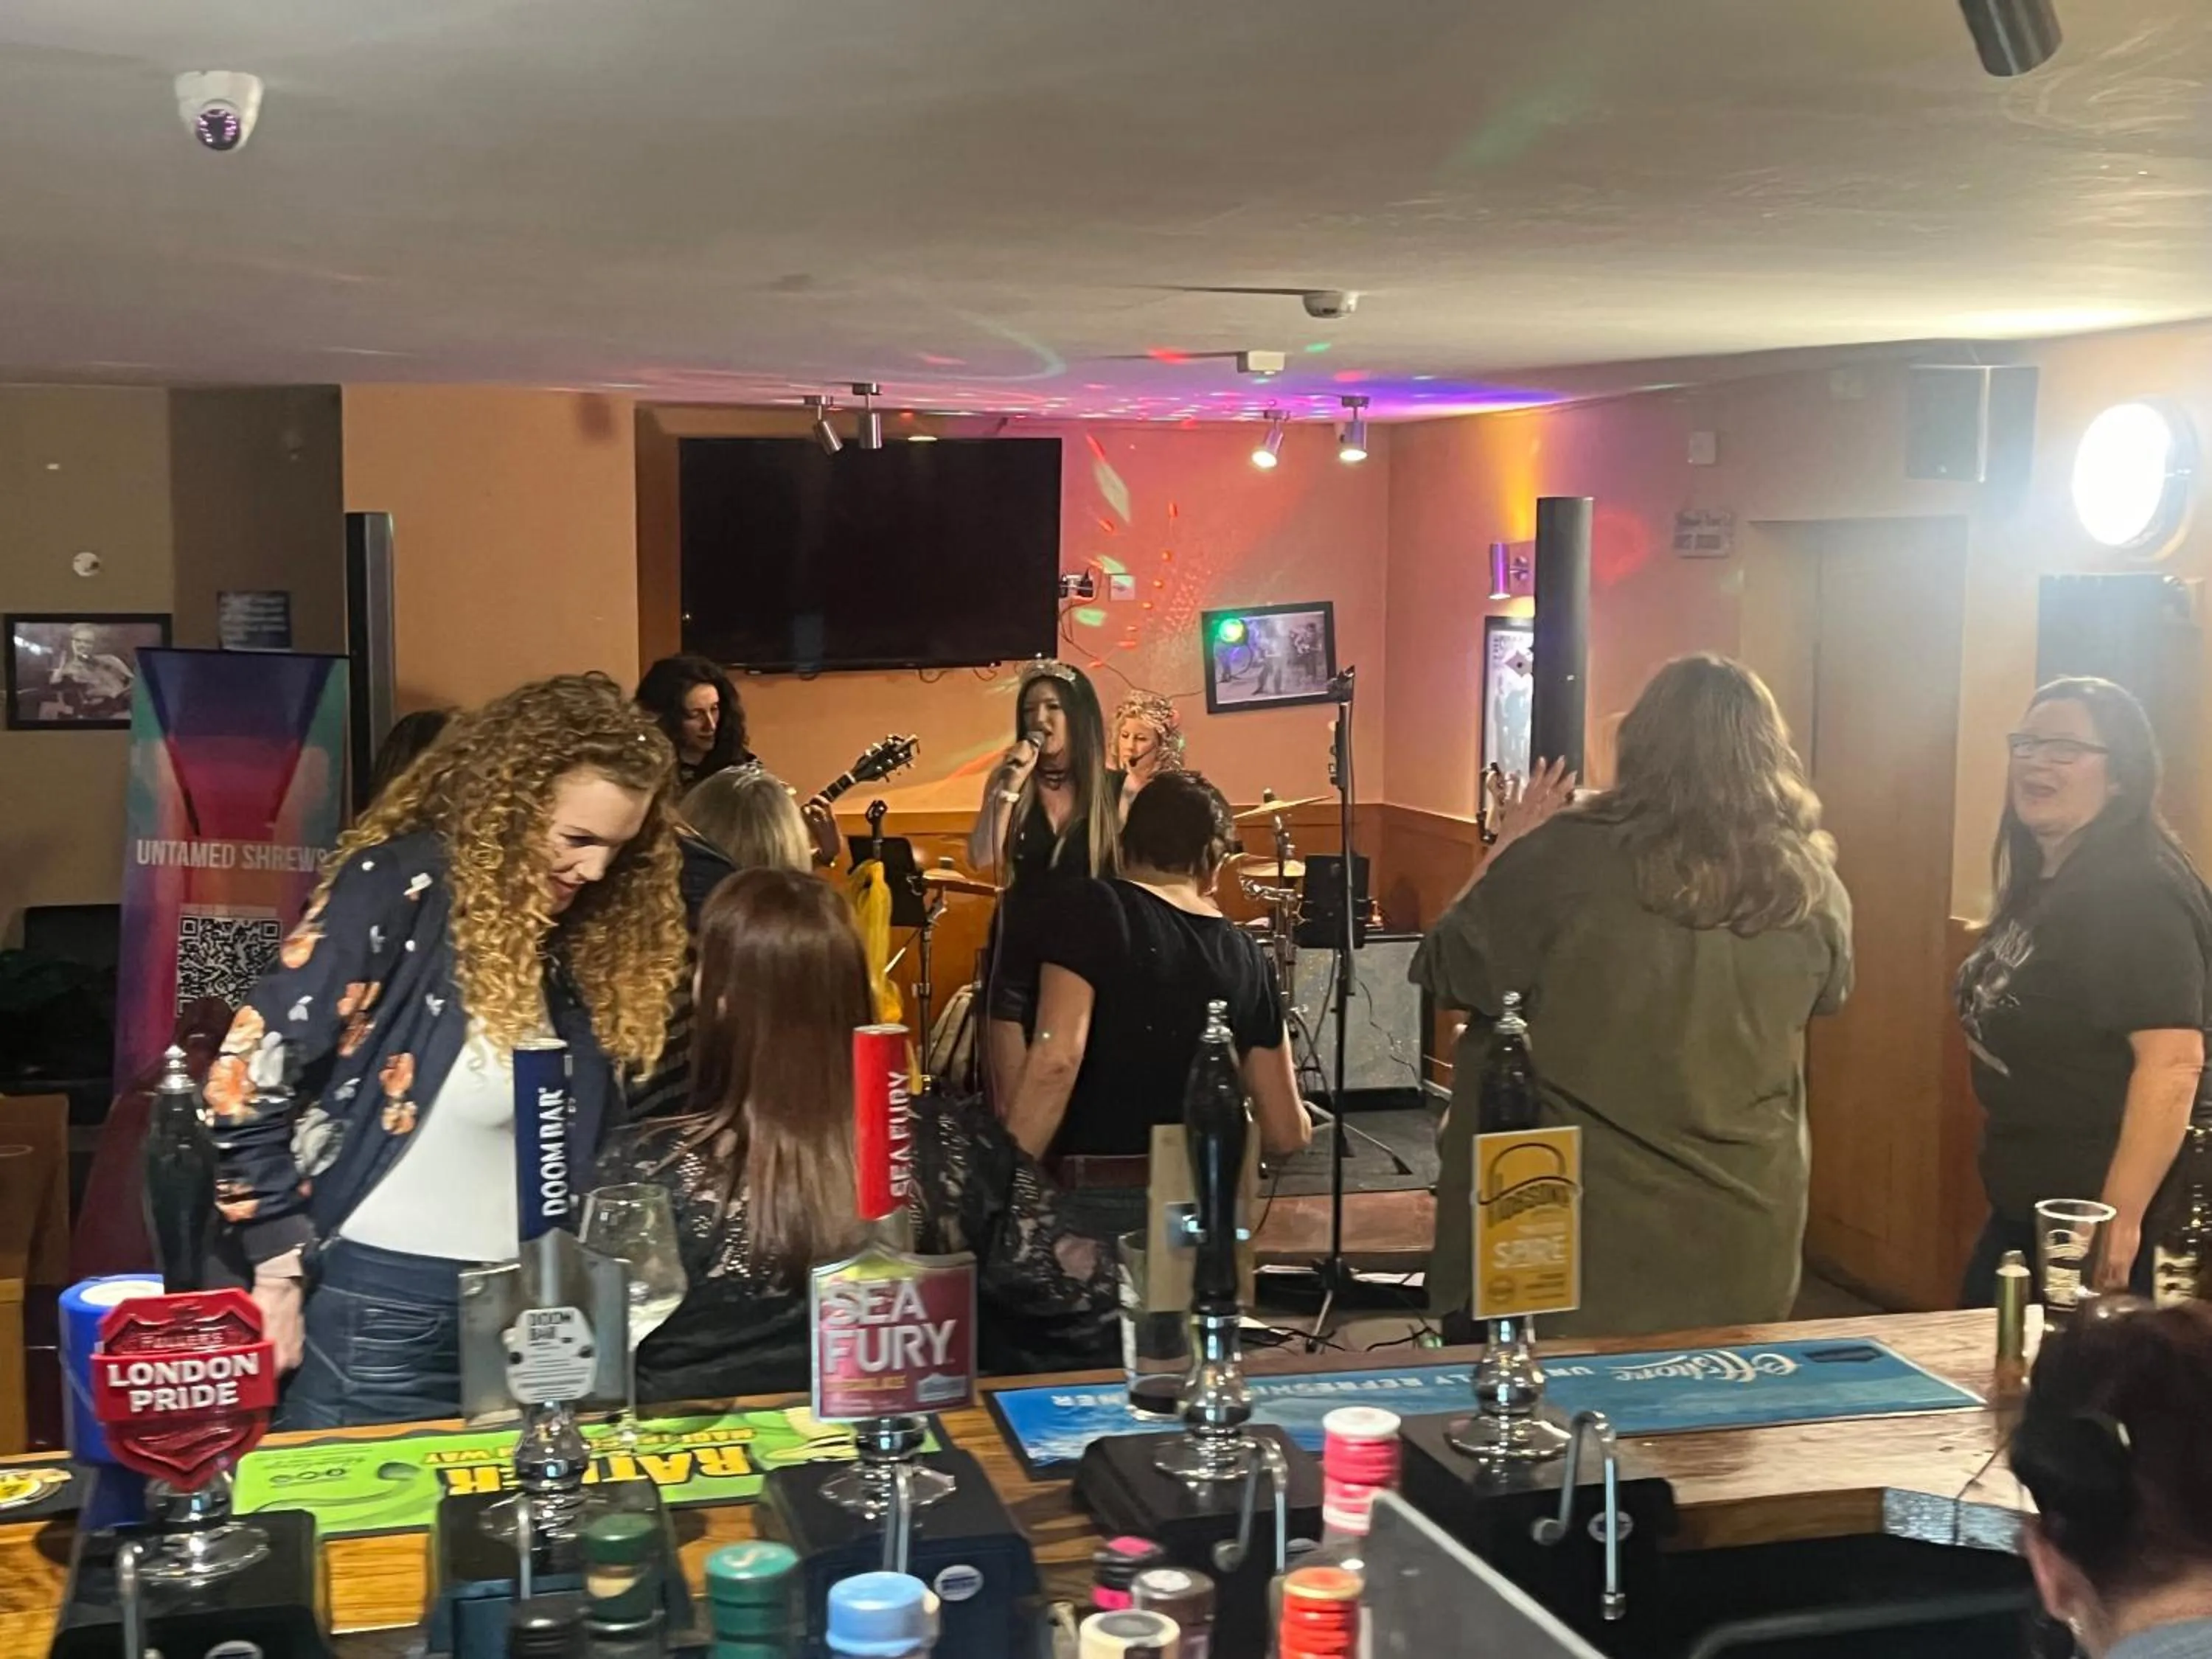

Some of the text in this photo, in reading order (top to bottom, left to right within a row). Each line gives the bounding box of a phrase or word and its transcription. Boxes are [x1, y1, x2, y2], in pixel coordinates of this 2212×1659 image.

[137, 839, 234, 869] UNTAMED
[538, 1089, 568, 1216] DOOM BAR
[887, 1071, 911, 1197] SEA FURY
[820, 1279, 928, 1326] SEA
[823, 1319, 957, 1374] FURY
[107, 1352, 260, 1387] LONDON
[128, 1380, 240, 1413] PRIDE
[423, 1449, 490, 1464] WAY
